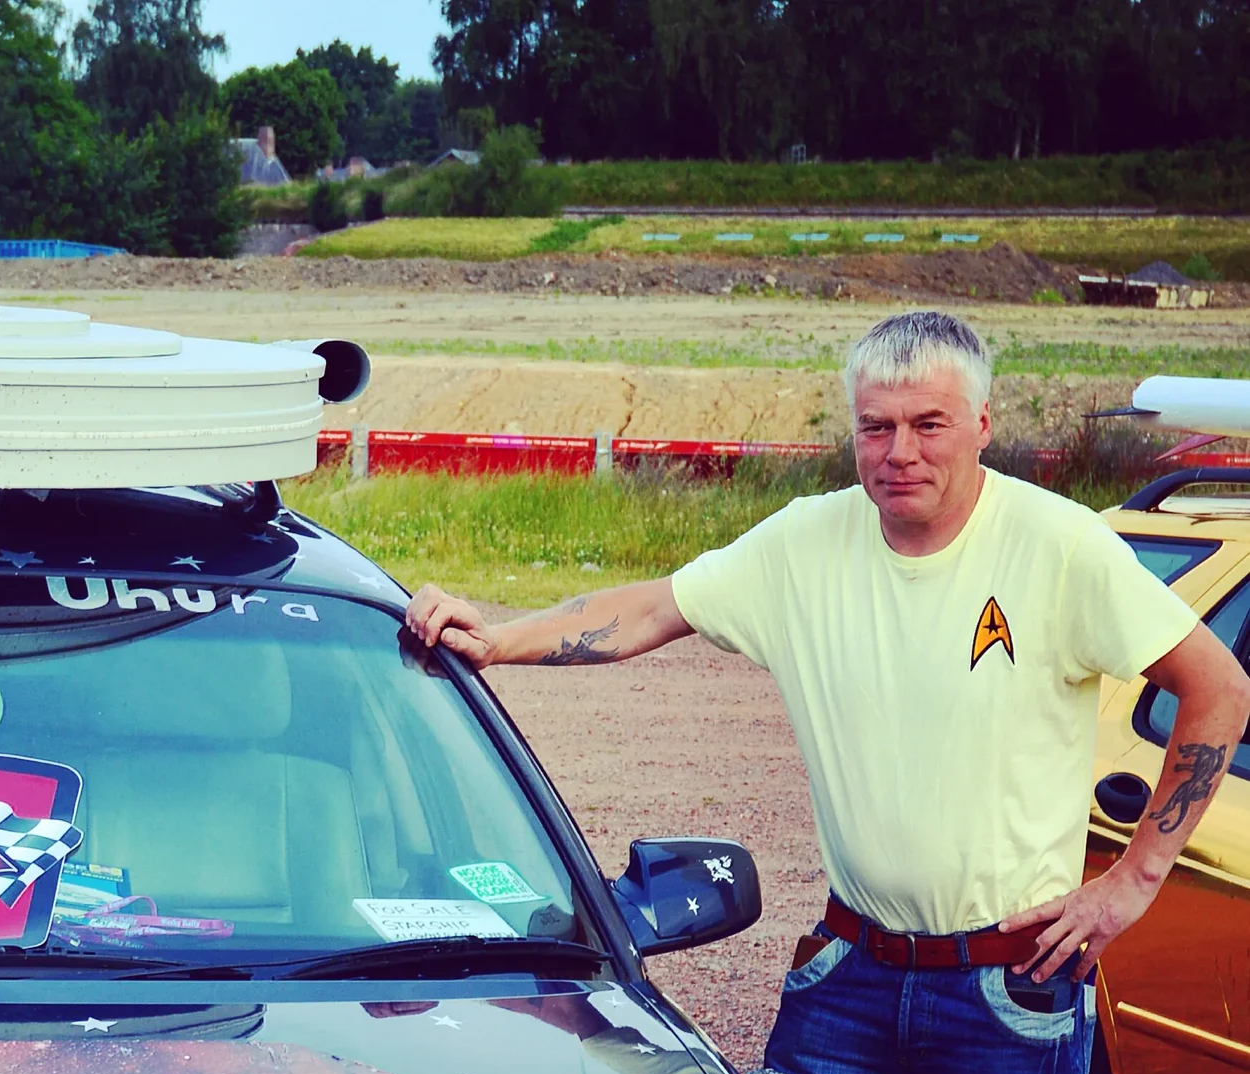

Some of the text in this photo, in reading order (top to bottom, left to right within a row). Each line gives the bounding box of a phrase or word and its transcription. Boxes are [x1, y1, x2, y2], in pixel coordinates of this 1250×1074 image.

[46, 576, 319, 621] Uhura
[367, 903, 473, 915] FOR SALE
[382, 920, 469, 931] STARSHIP
